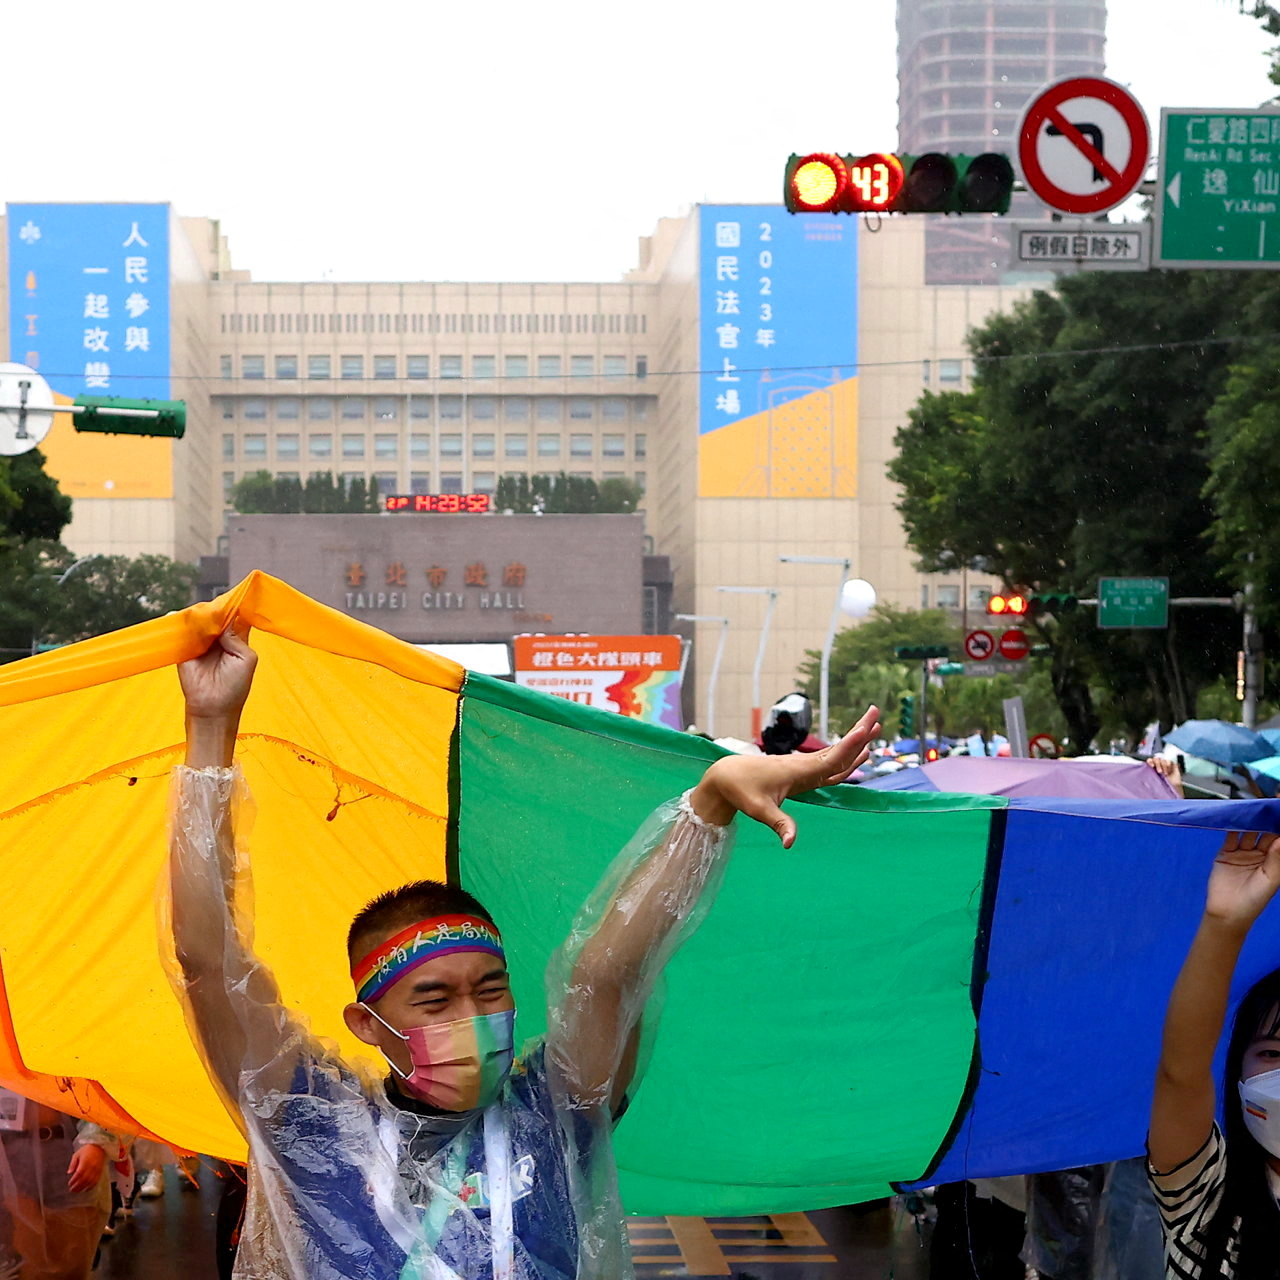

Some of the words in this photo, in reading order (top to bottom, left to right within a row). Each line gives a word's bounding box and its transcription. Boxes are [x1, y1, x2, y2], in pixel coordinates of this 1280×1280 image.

[1226, 149, 1243, 162] Rd
[1250, 149, 1272, 163] Sec
[851, 163, 890, 204] 43
[1223, 199, 1276, 214] YiXian
[1028, 235, 1133, 257] 例假日除外
[123, 222, 150, 352] 人民參與
[755, 222, 776, 348] 2023年
[83, 267, 111, 388] 一起改變
[715, 221, 741, 414] 國民法官上場
[415, 494, 489, 513] 14:23:52
[345, 592, 407, 609] TAIPEI
[422, 592, 465, 609] CITY
[480, 592, 526, 609] HALL
